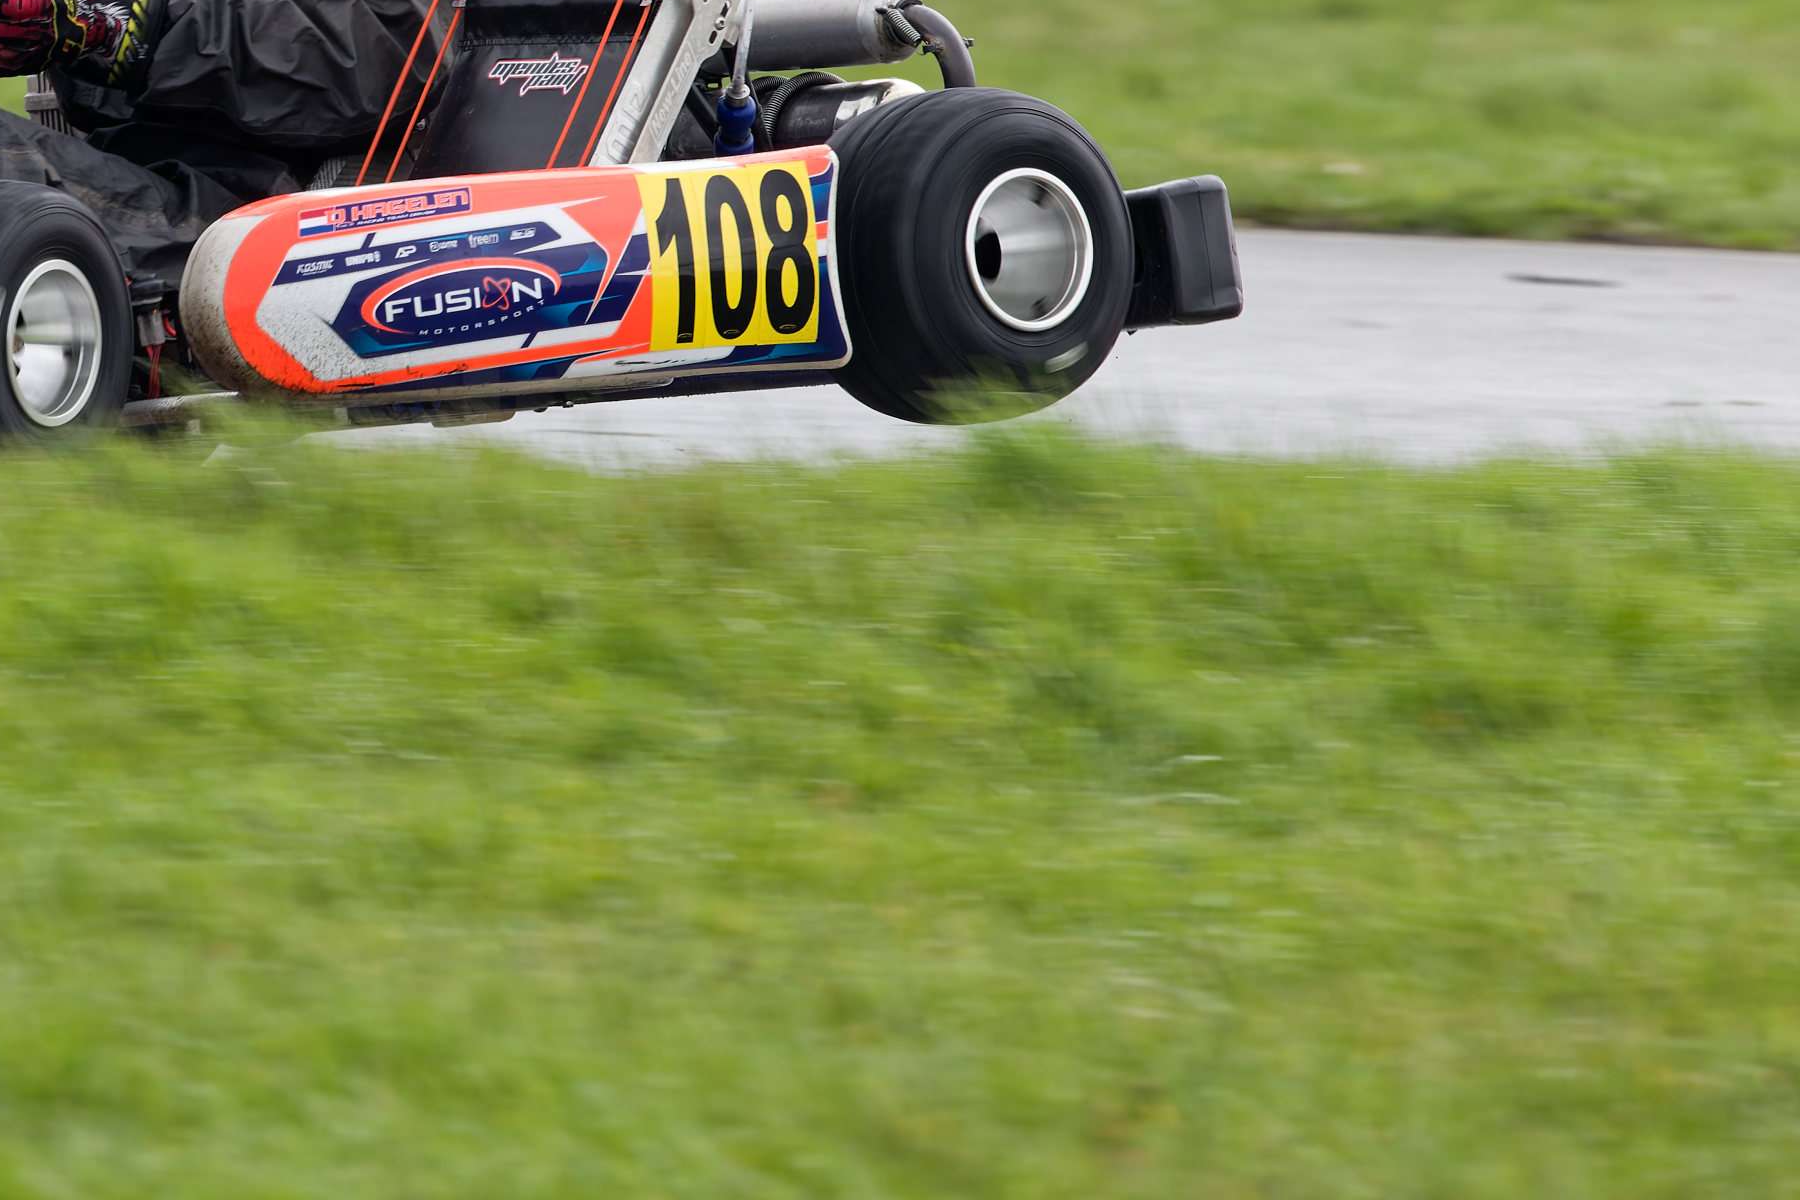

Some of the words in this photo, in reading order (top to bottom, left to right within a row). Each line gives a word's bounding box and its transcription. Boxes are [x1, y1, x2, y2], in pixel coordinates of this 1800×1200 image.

[655, 169, 815, 344] 108
[384, 276, 543, 323] FUSION
[418, 299, 545, 336] MOTORSPORT
